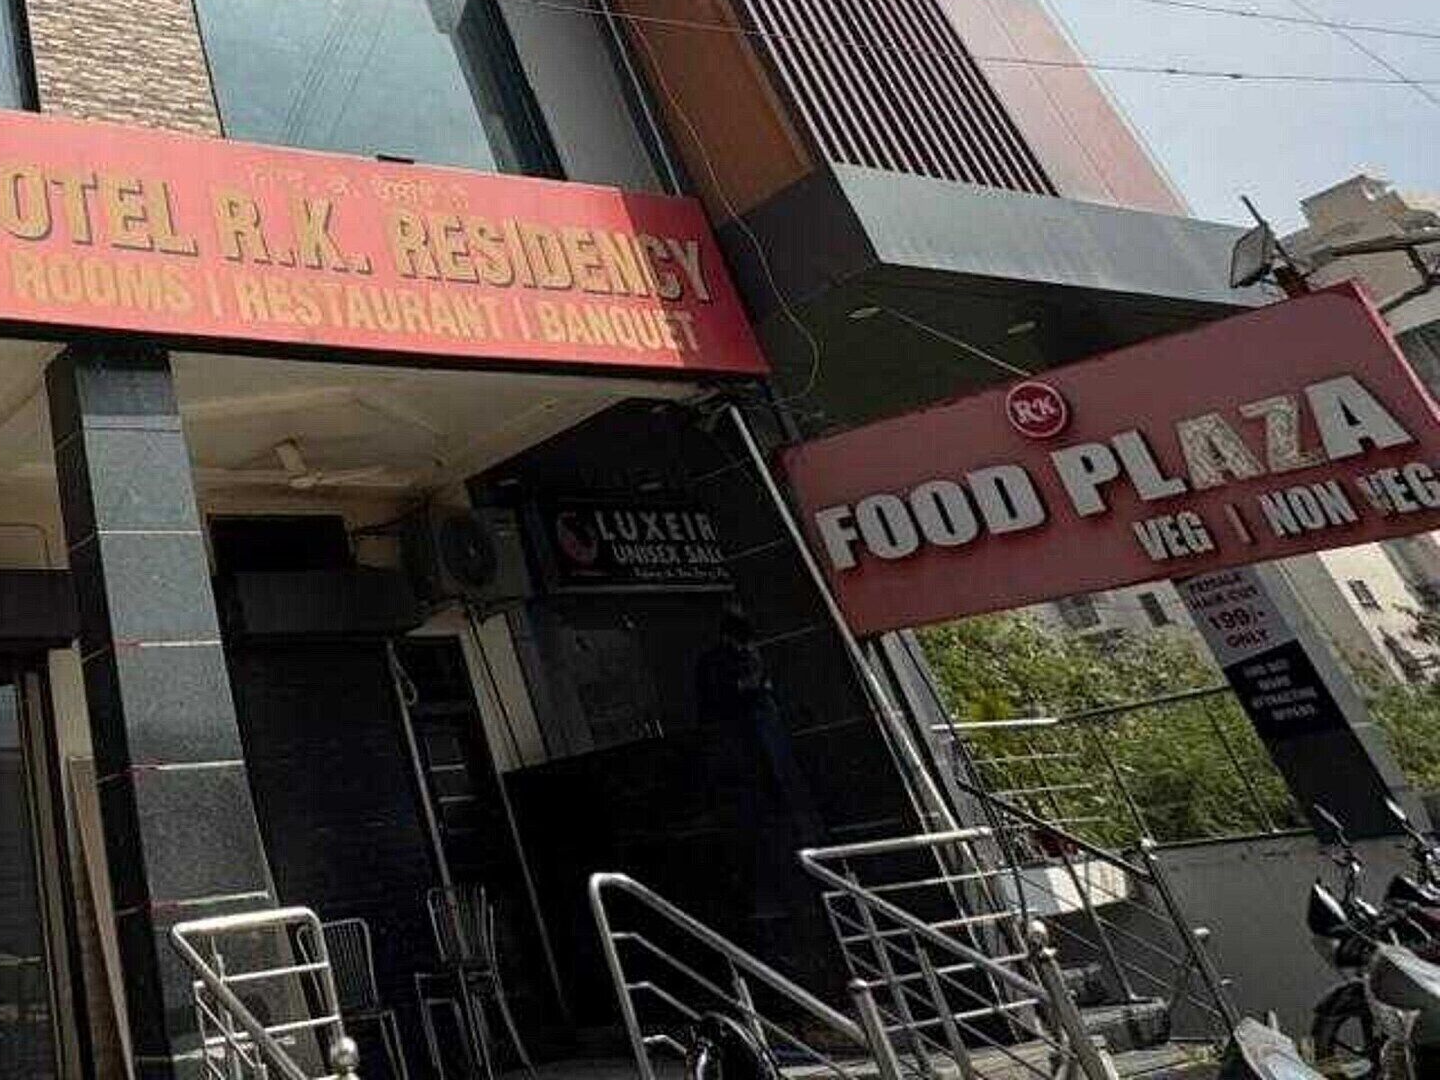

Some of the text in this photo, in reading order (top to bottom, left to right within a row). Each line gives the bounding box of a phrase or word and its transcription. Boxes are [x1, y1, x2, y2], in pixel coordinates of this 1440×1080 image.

[216, 184, 372, 275] R.K.
[392, 210, 713, 304] RESIDENCY
[9, 251, 193, 314] ROOMS
[236, 278, 505, 341] RESTAURANT
[540, 300, 701, 354] BANQUET
[816, 375, 1415, 571] FOOD PLAZA
[1132, 512, 1212, 562] VEG
[1258, 480, 1359, 539] NON
[1354, 461, 1440, 516] VEG
[1224, 628, 1269, 649] ONLY
